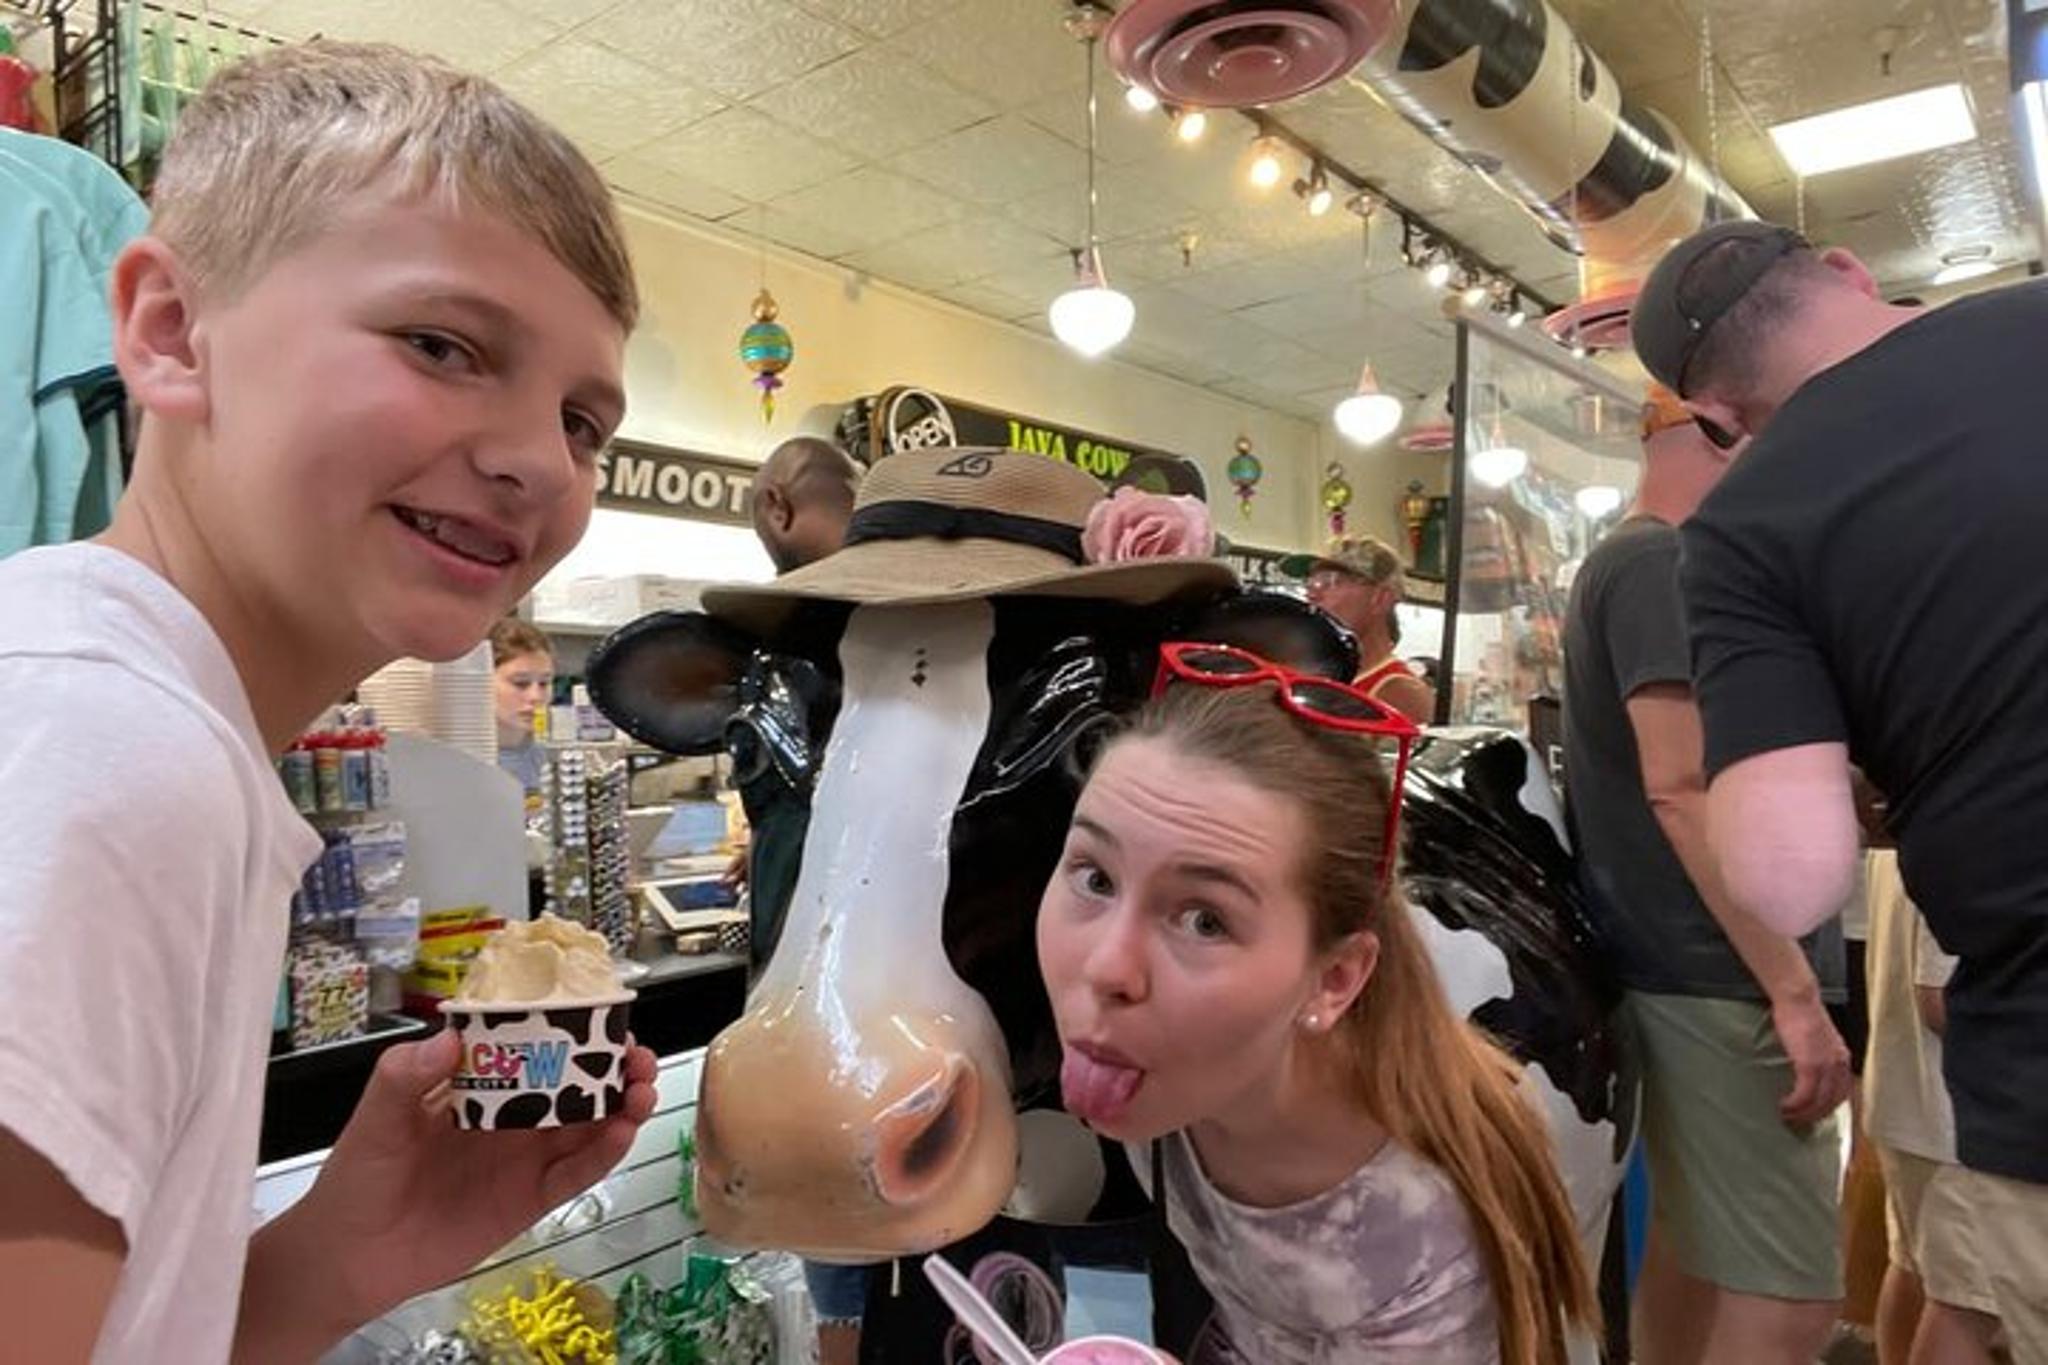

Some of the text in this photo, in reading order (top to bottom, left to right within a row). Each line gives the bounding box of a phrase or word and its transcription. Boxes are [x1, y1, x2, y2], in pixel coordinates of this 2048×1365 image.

[1008, 420, 1132, 478] JAVA COW
[594, 454, 753, 513] SMOOT
